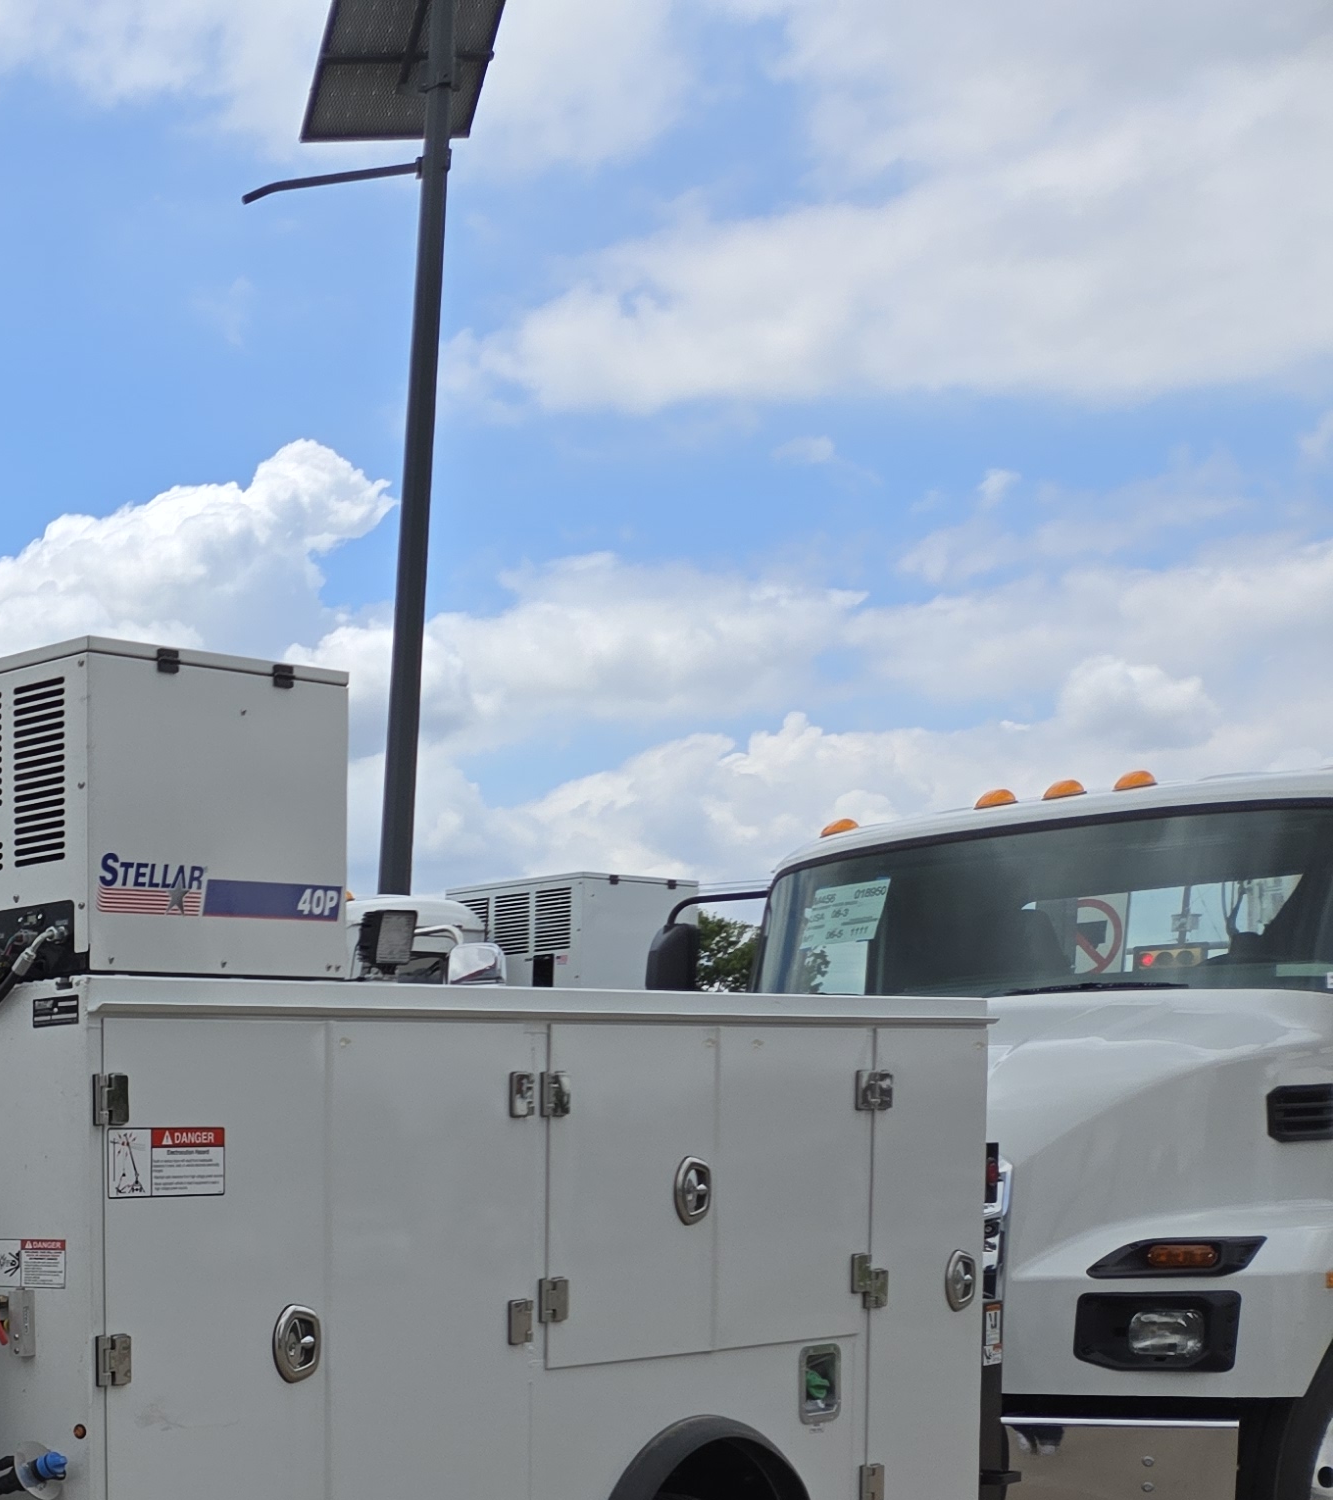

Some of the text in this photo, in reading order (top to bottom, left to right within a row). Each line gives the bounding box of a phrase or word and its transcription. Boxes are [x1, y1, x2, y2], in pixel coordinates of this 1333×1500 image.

[99, 852, 339, 916] STELLAR 40P
[174, 1131, 215, 1144] DANGER
[32, 1241, 61, 1249] DANGER
